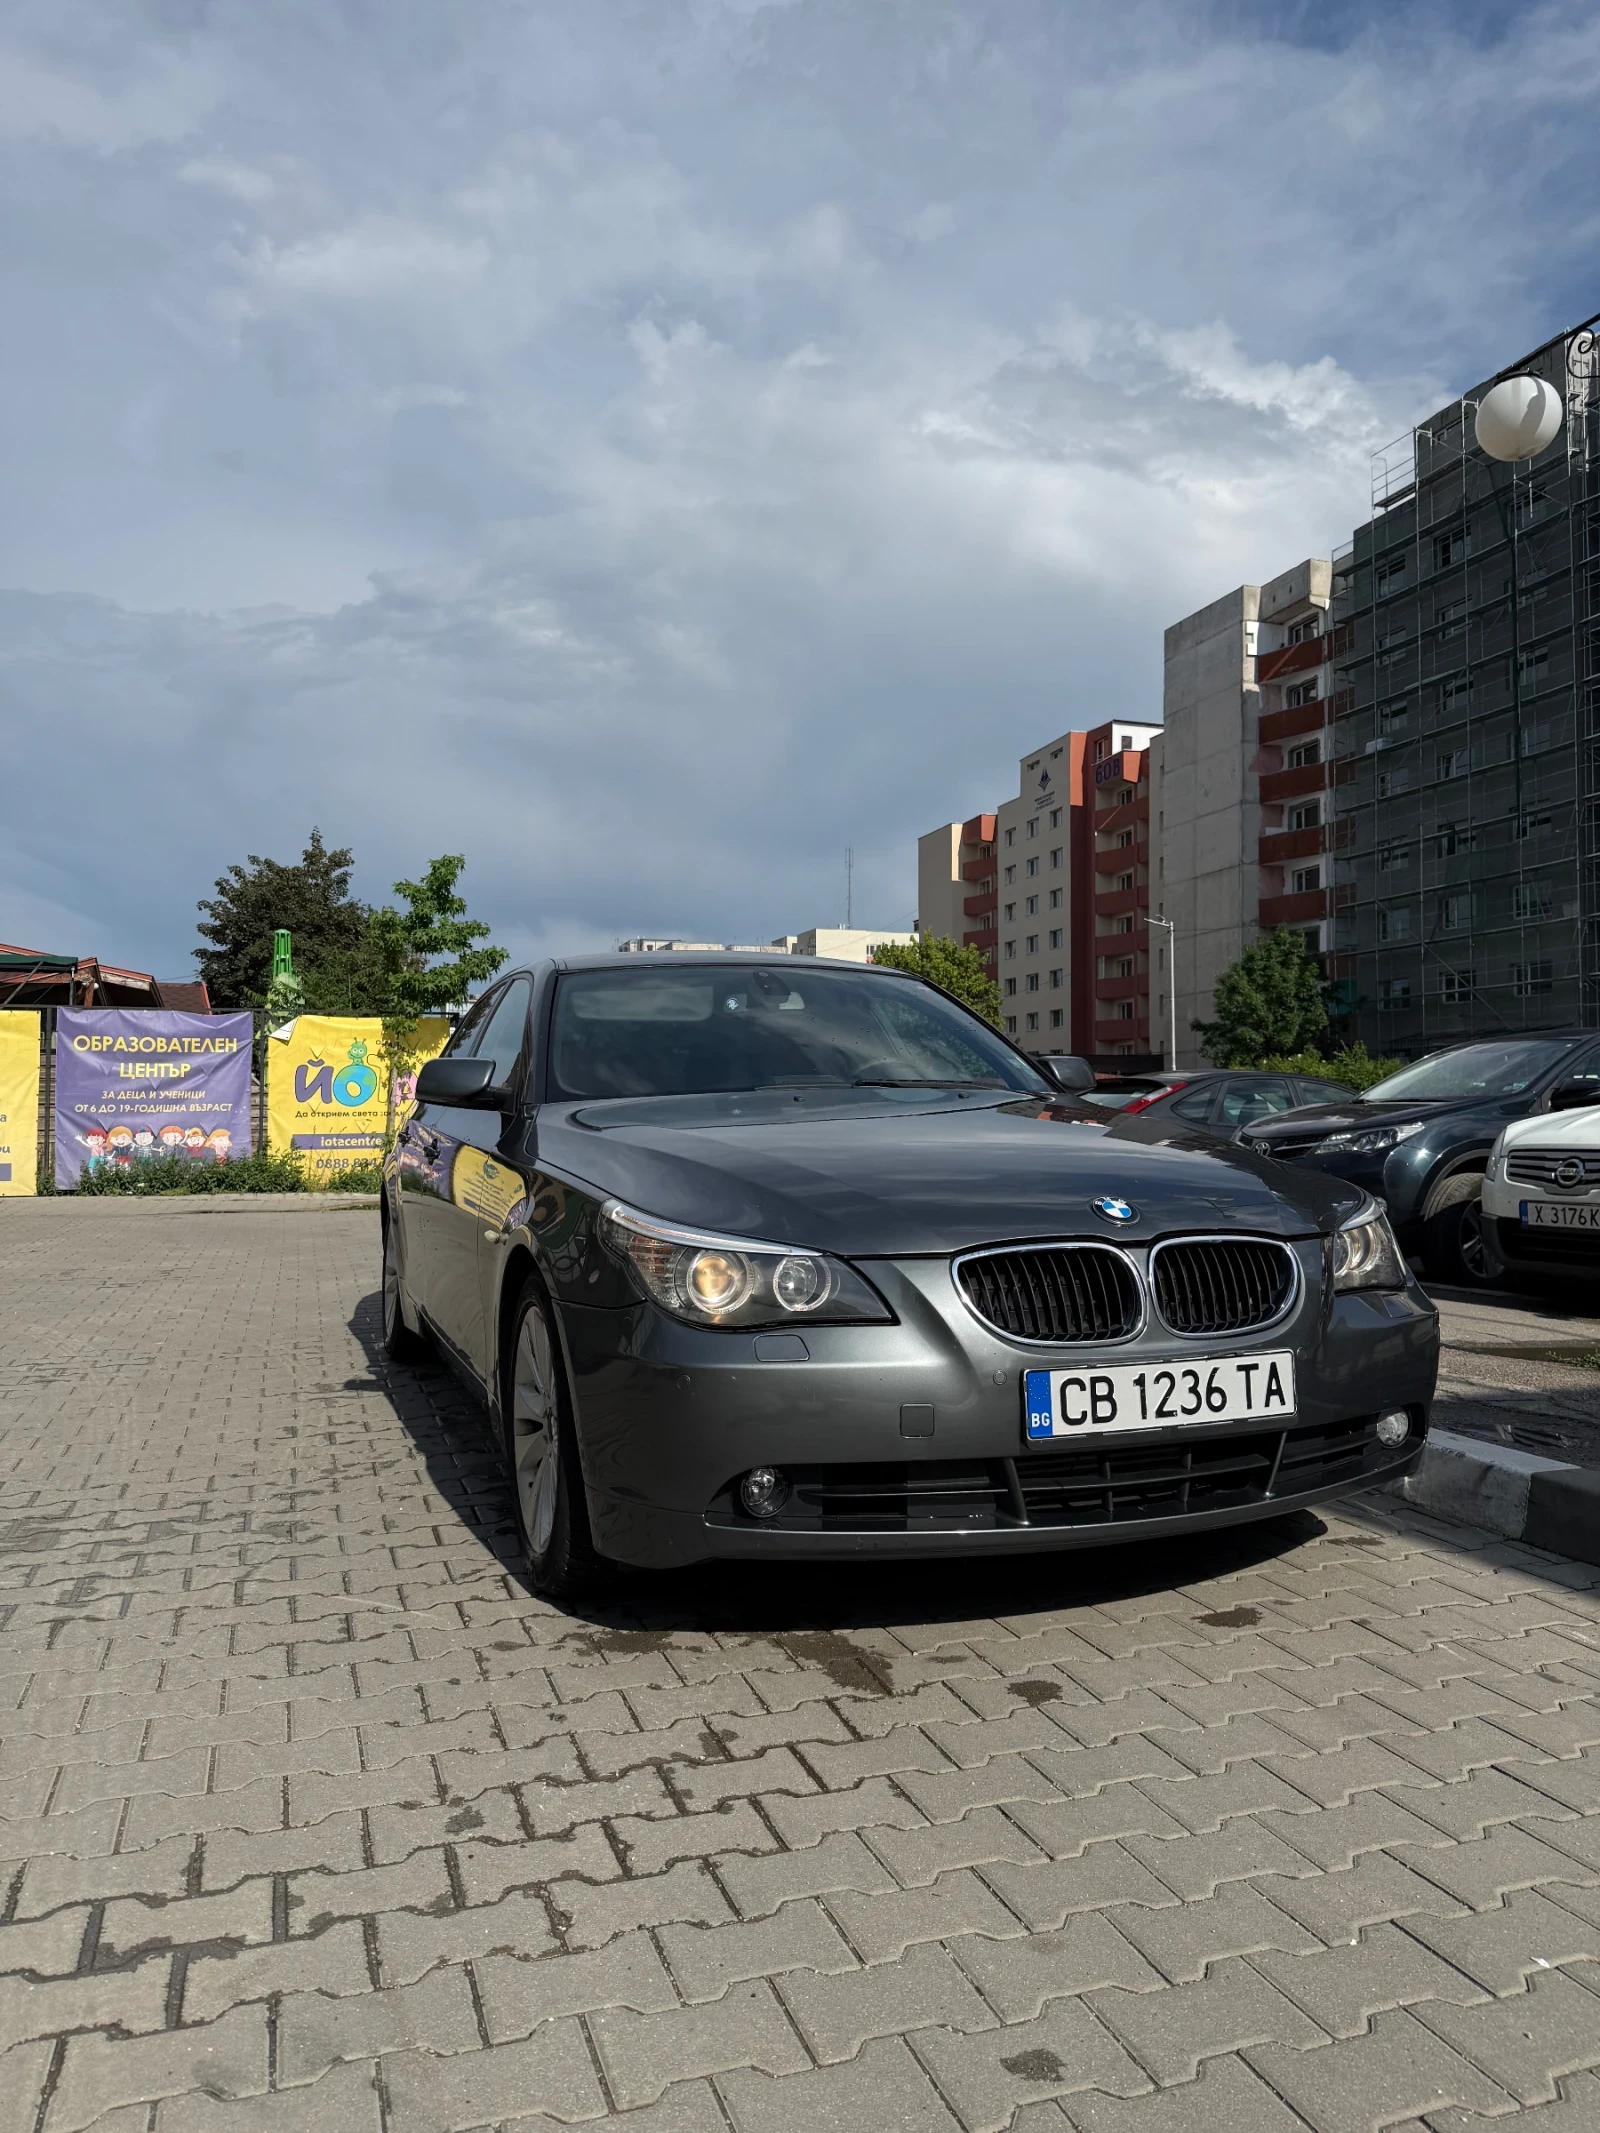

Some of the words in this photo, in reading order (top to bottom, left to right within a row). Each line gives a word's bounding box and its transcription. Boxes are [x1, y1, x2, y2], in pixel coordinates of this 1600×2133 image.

[73, 1035, 237, 1053] ОБРАЗОВАТЕЛЕН
[119, 1063, 191, 1080] ЦЕНТЪР
[101, 1090, 116, 1099] ЗА
[117, 1090, 146, 1100] ДЕЦА
[149, 1090, 157, 1099] И
[159, 1090, 206, 1099] УЧЕНИЦИ
[74, 1104, 88, 1113] ОТ
[90, 1104, 97, 1113] 6
[98, 1104, 116, 1113] ДО
[119, 1104, 187, 1113] 19-ГОДИШНА
[189, 1103, 233, 1112] ВЪЗРАСТ
[316, 1158, 349, 1169] 0888
[1534, 1205, 1544, 1223] X
[1551, 1207, 1587, 1225] 3176
[1059, 1376, 1117, 1426] CB
[1133, 1367, 1227, 1420] 1236
[1236, 1361, 1286, 1410] TA
[1031, 1412, 1050, 1427] BG
